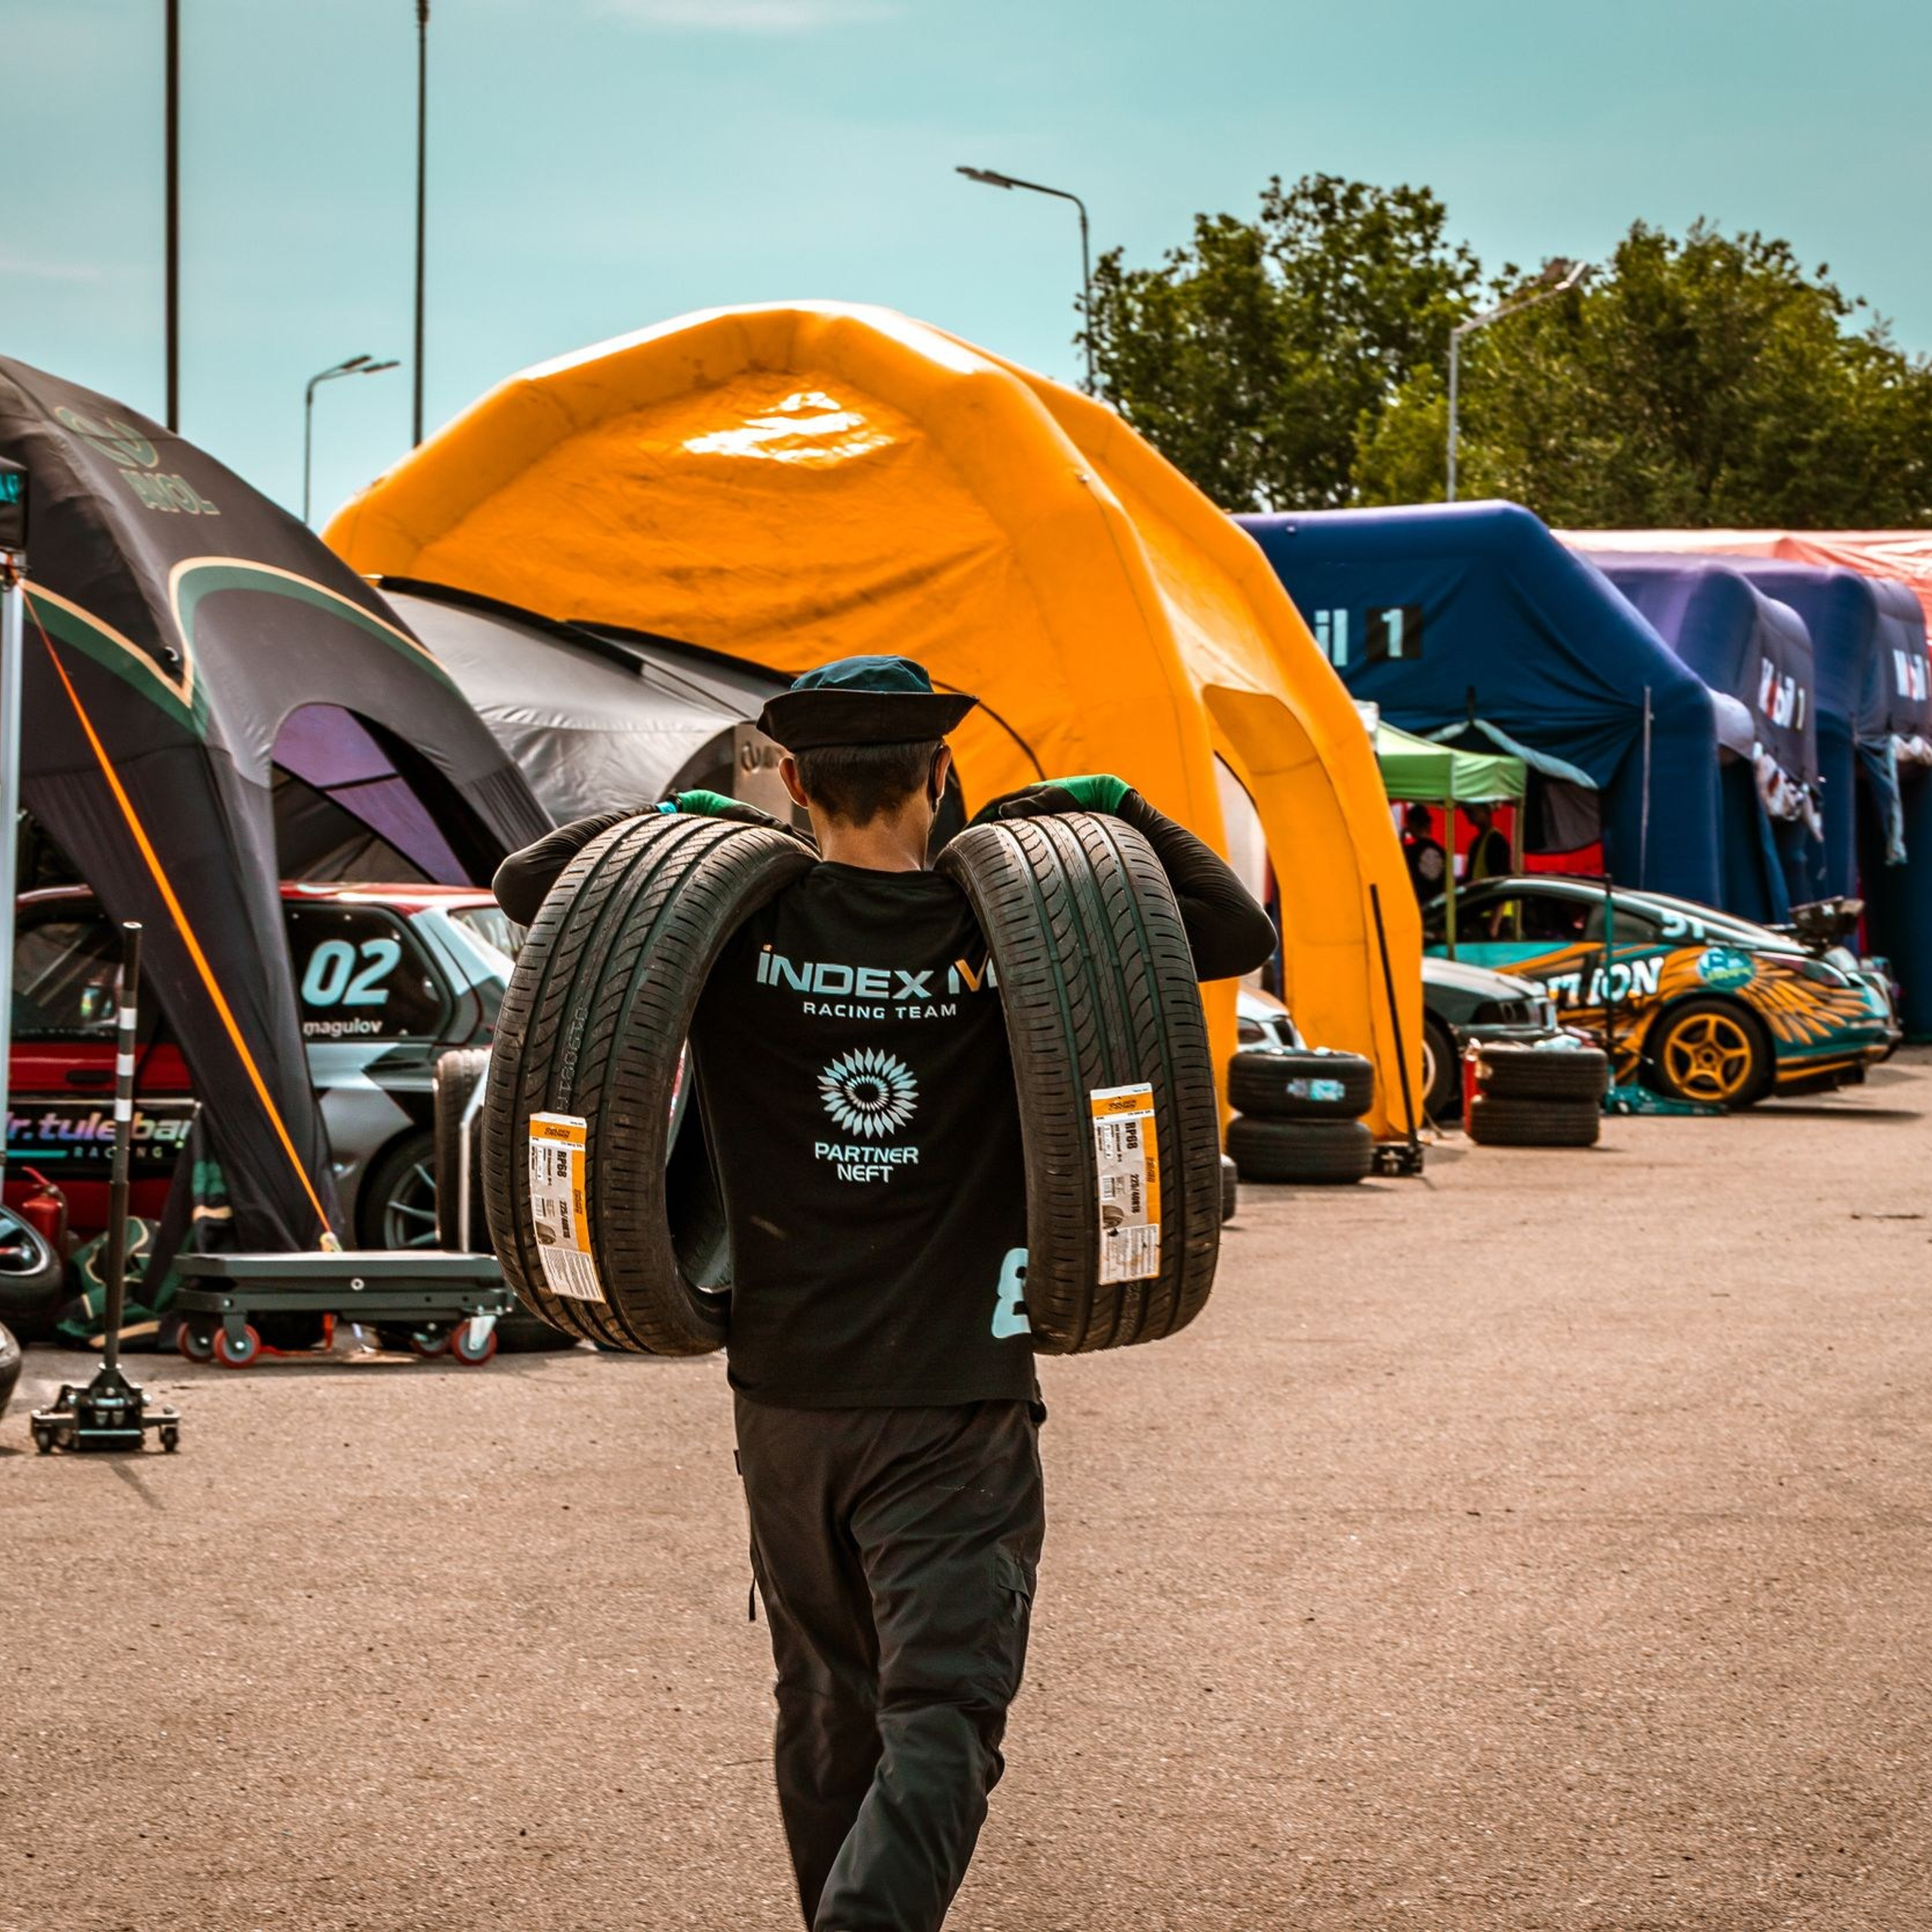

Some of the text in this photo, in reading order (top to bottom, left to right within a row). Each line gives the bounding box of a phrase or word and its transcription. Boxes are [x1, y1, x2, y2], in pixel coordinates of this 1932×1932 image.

[1381, 608, 1403, 658] 1
[301, 938, 402, 1007] 02
[803, 1001, 957, 1019] RACING TEAM
[74, 1146, 163, 1158] RACNG
[814, 1141, 919, 1164] PARTNER
[556, 1149, 568, 1179] RP68
[836, 1163, 894, 1183] NEFT
